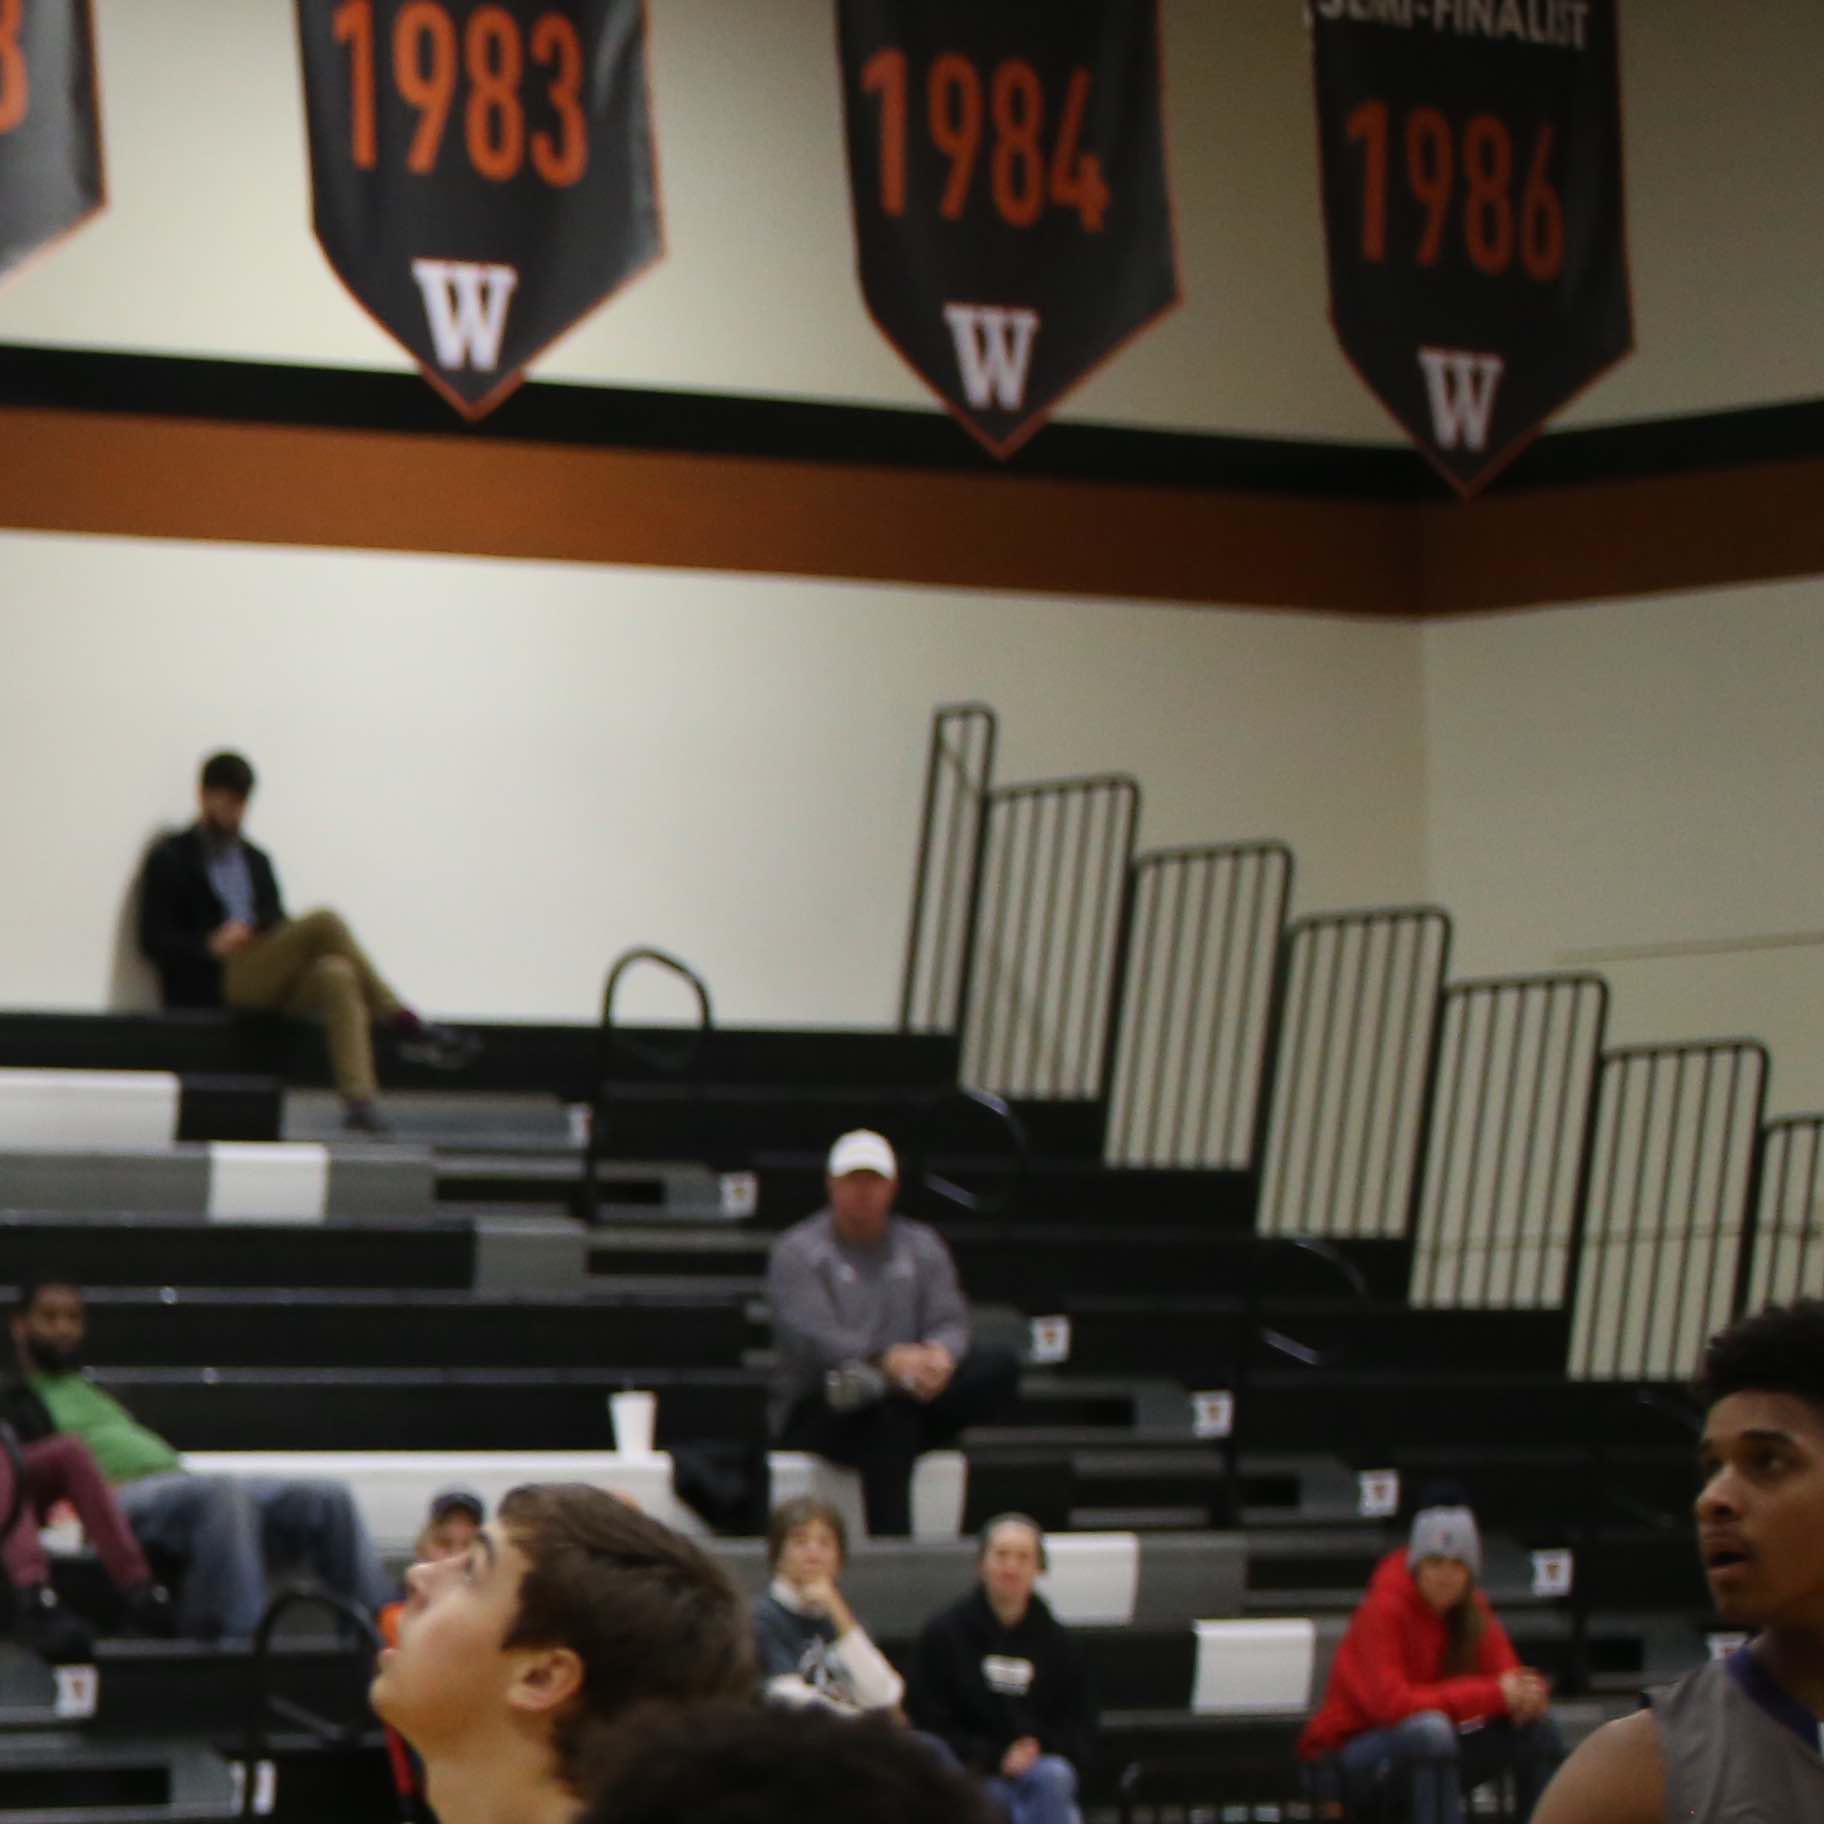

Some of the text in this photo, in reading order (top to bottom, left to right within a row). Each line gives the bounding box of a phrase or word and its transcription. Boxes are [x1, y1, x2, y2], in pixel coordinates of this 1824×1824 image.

[332, 2, 590, 188] 1983
[861, 48, 1112, 234] 1984
[1348, 100, 1566, 281] 1986
[411, 259, 517, 371] W
[943, 302, 1039, 409] W
[1417, 345, 1504, 450] W
